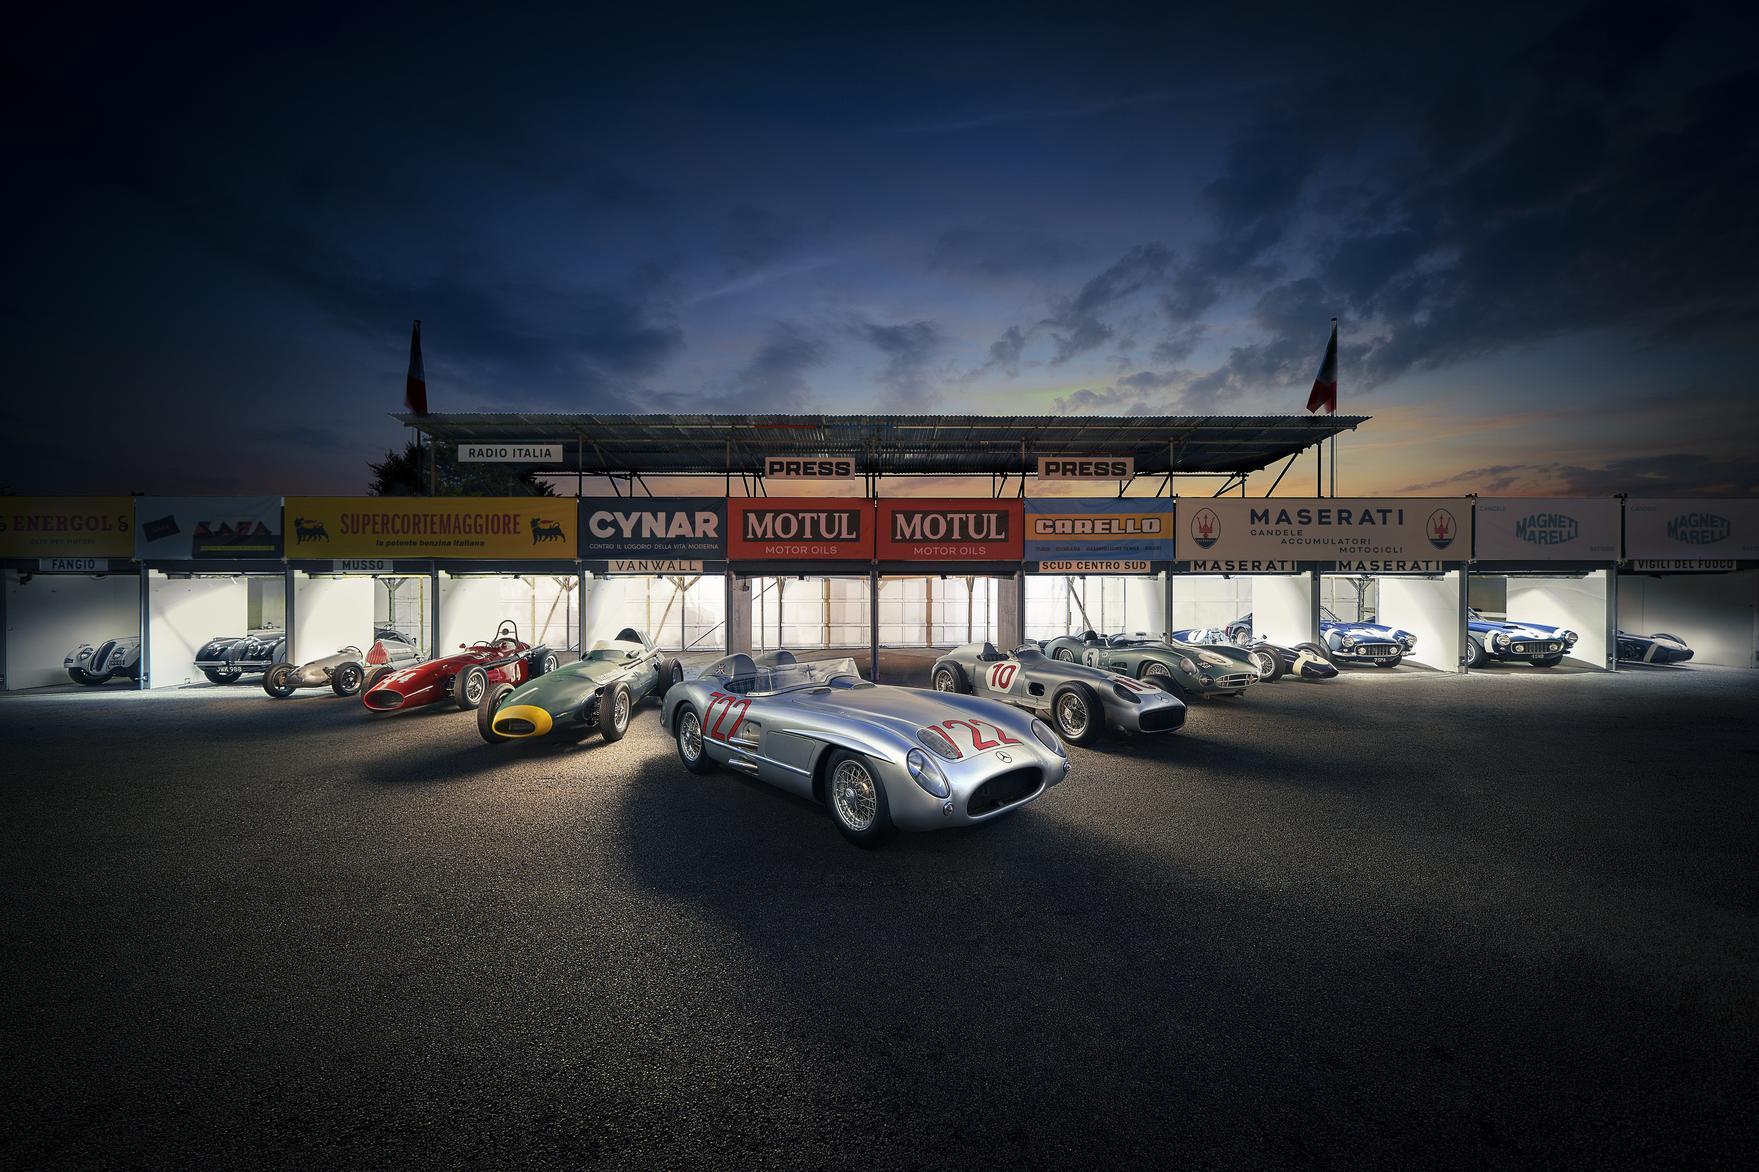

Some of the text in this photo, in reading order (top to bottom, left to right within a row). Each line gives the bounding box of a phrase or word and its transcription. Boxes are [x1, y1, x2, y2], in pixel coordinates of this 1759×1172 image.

[468, 448, 552, 458] RADIO ITALIA
[769, 461, 851, 476] PRESS
[1044, 461, 1127, 476] PRESS
[1250, 508, 1404, 526] MASERATI
[13, 515, 113, 531] ENERGOL
[340, 513, 521, 535] SUPERCORTEMAGGIORE
[589, 510, 719, 538] CYNAR
[746, 512, 857, 539] MOTUL
[895, 513, 1006, 540] MOTUL
[1035, 518, 1161, 535] CARELLO
[1250, 529, 1303, 537] CANDELE
[419, 539, 452, 547] benzina
[453, 539, 485, 547] italiana
[765, 546, 838, 555] MOTOR OILS
[914, 546, 986, 555] MOTOR OILS
[1339, 546, 1403, 554] MOTOCICLI
[52, 560, 95, 569] FANGIO
[342, 560, 384, 570] MUSSO
[615, 560, 697, 571] VANWALL
[1042, 561, 1147, 570] SCUD CENTRO SUD
[1193, 560, 1295, 571] MASERATI
[1338, 560, 1440, 571] MASERATI
[1638, 560, 1733, 569] VIGILI DEL FUOCO
[1085, 651, 1095, 668] 5
[991, 663, 1017, 690] 10
[703, 691, 752, 744] 722
